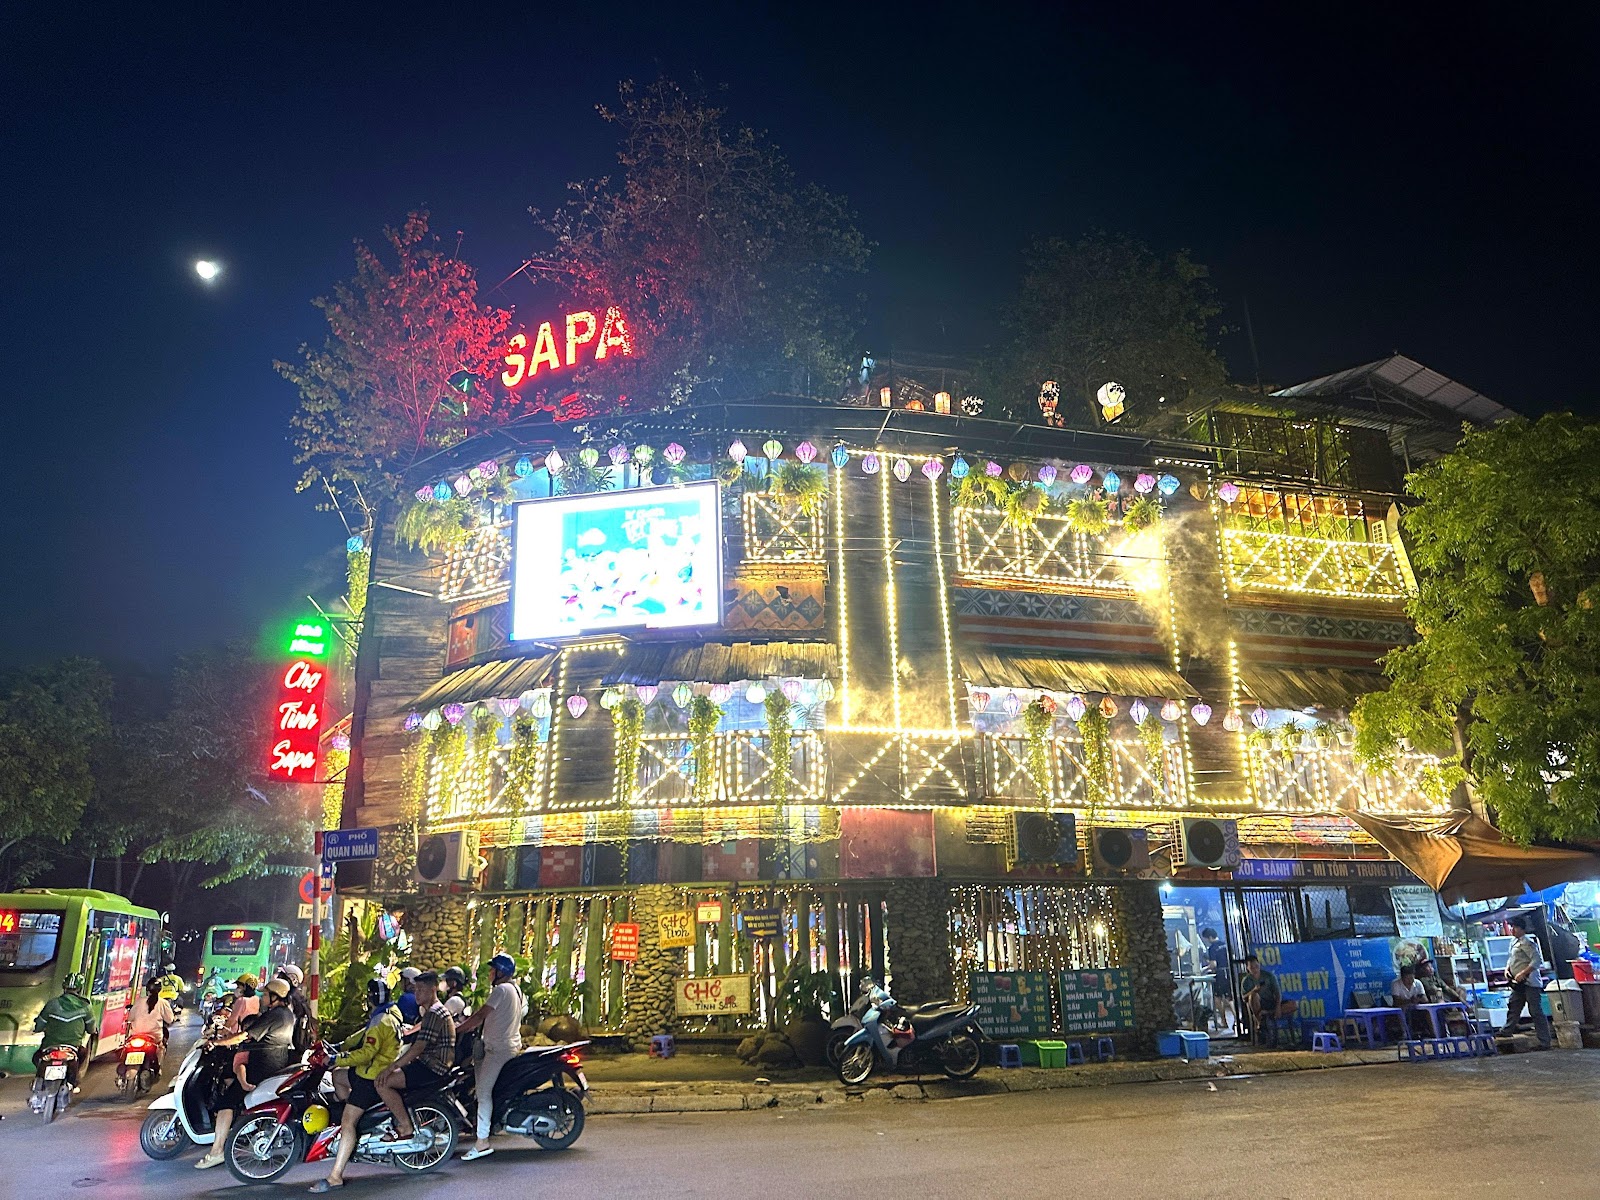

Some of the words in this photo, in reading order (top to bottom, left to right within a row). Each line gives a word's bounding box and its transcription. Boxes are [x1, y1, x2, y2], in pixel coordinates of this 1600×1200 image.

[502, 306, 631, 387] SAPA
[284, 661, 322, 693] Chợ
[279, 701, 319, 730] Tình
[271, 740, 316, 776] Sapa
[348, 831, 368, 840] PHỐ
[328, 846, 350, 858] QUAN
[352, 842, 375, 856] NHÂN
[1238, 860, 1254, 876] XÔI
[1263, 861, 1290, 876] BÁNH
[1292, 861, 1305, 876] MÌ
[1313, 862, 1326, 876] MÌ
[1327, 861, 1348, 876] TÔM
[1356, 862, 1387, 876] TRỨNG
[1389, 864, 1401, 879] VỊT
[0, 914, 14, 932] 4
[1255, 944, 1282, 966] XÔI
[1306, 966, 1329, 990] MỲ
[684, 980, 722, 1002] CHỢ
[695, 1000, 716, 1010] TÌNH
